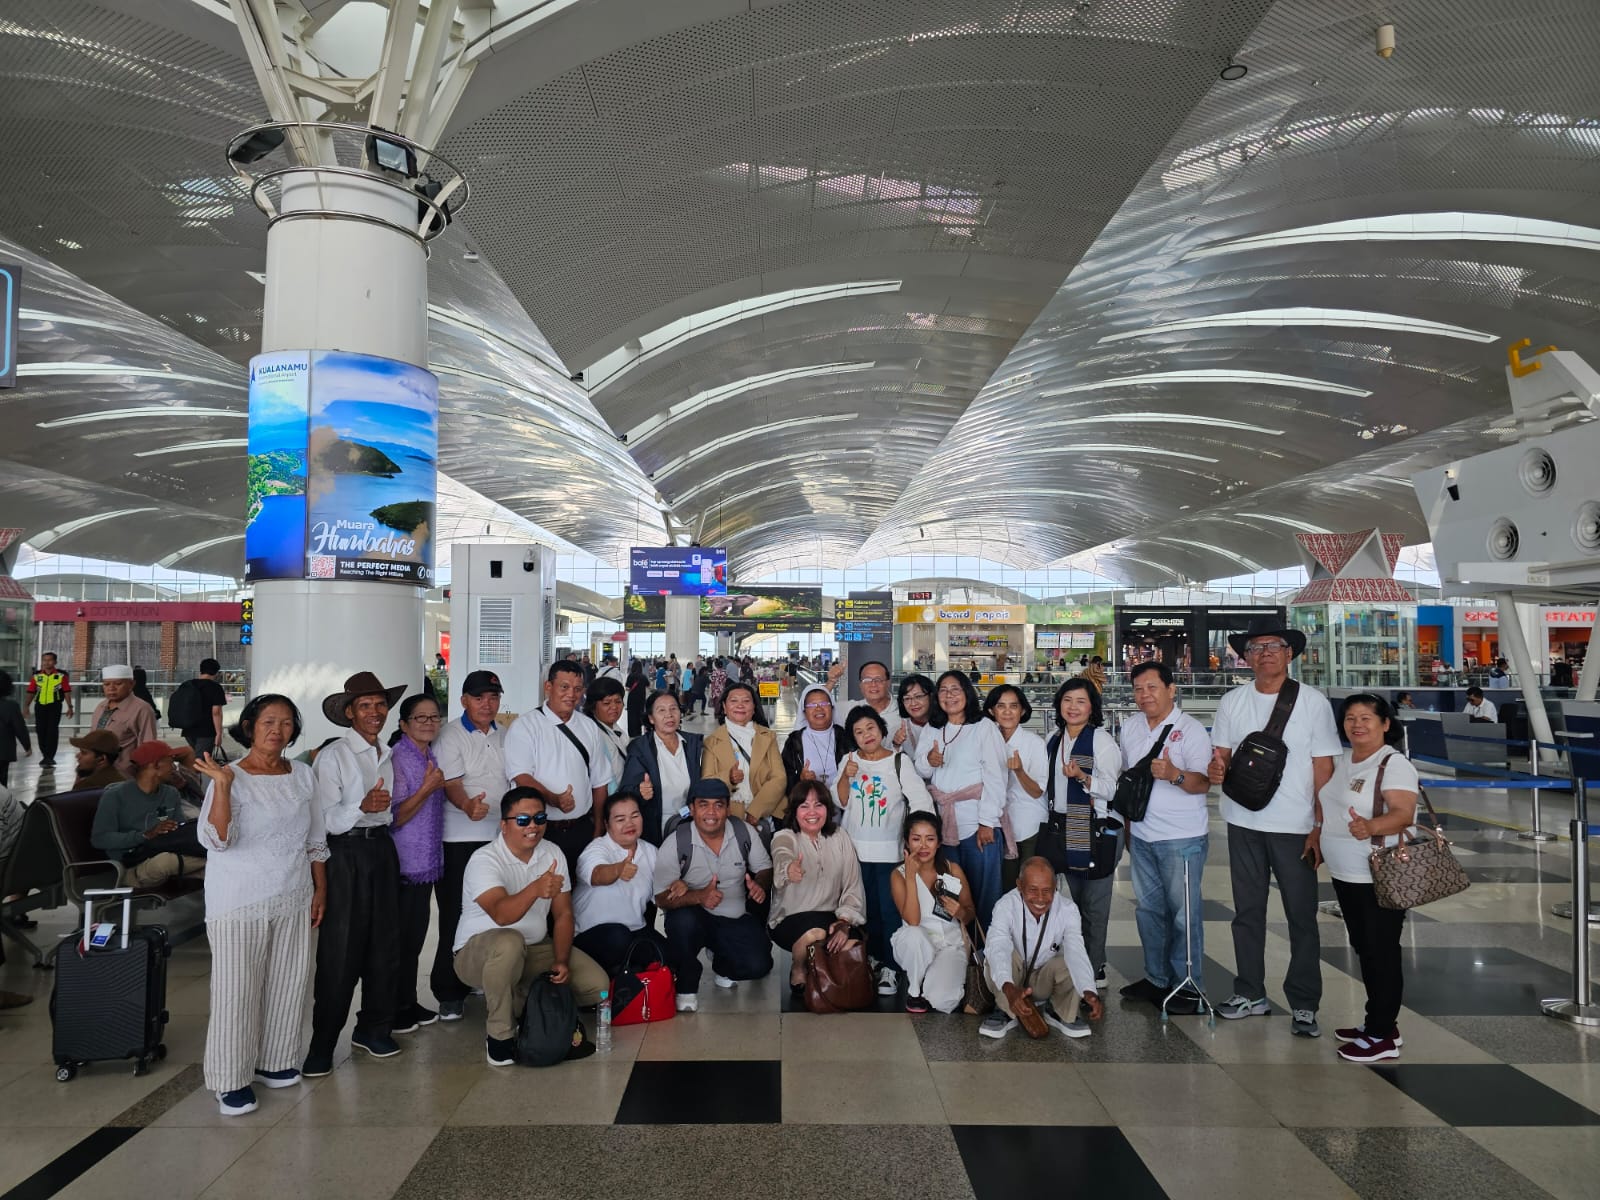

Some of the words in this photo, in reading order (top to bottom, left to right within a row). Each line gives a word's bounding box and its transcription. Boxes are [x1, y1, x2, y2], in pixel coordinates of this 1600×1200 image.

[258, 363, 308, 375] KUALANAMU
[336, 519, 376, 531] Muara
[340, 561, 355, 569] THE
[357, 562, 389, 571] PERFECT
[390, 563, 411, 573] MEDIA
[939, 610, 970, 619] beard
